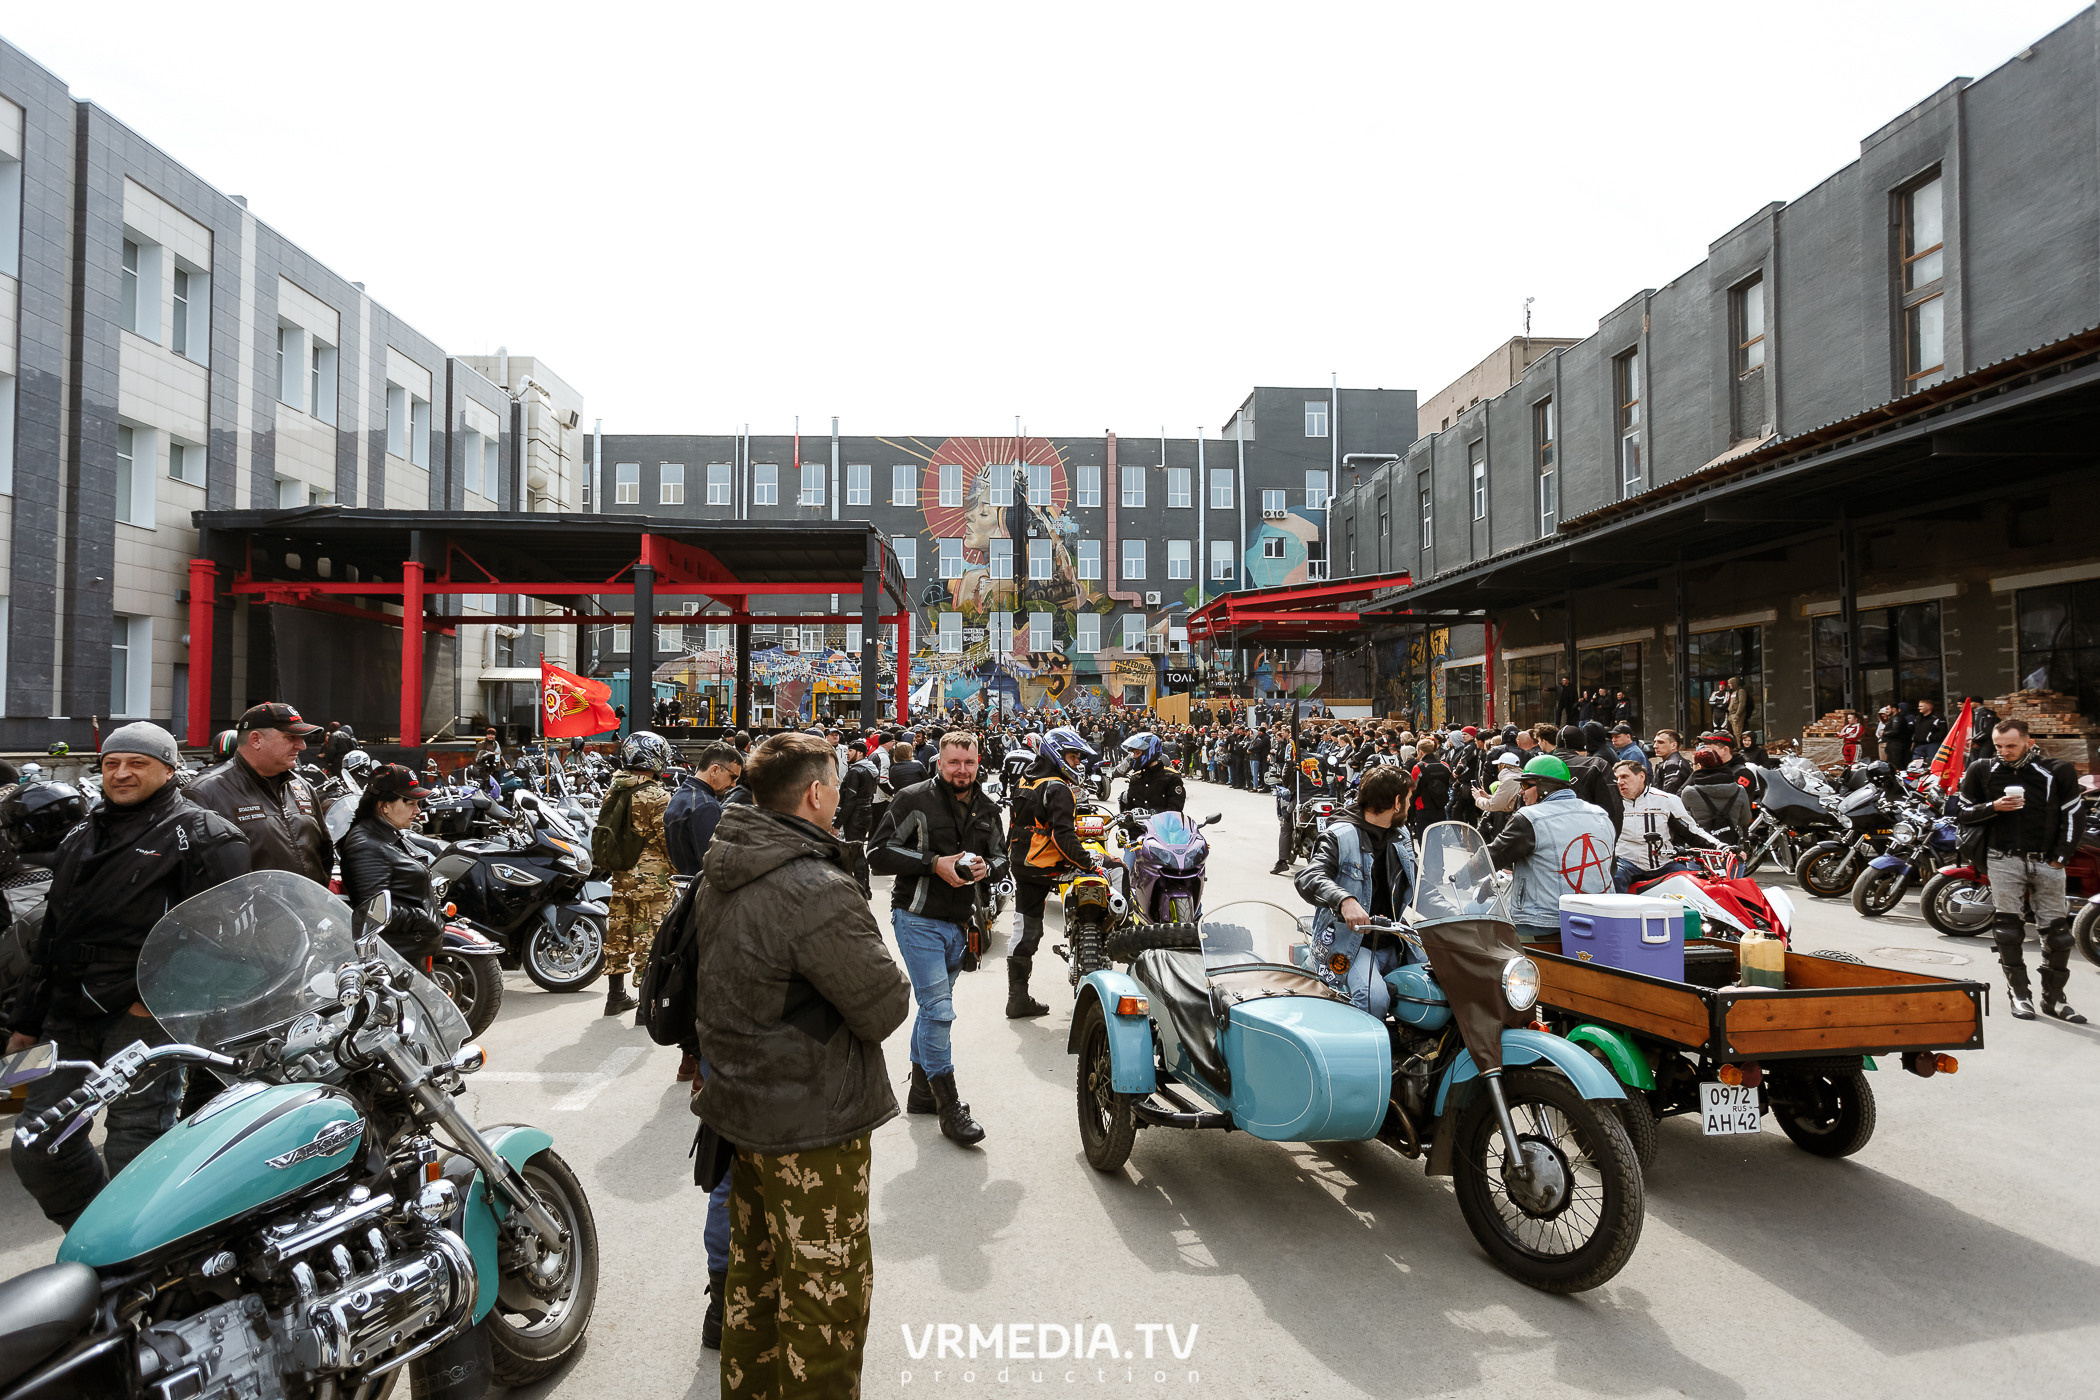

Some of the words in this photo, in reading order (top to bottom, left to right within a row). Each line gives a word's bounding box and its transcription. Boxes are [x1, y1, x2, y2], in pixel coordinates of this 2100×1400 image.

[1009, 761, 1026, 775] 71
[1710, 1087, 1750, 1105] 0972
[1738, 1112, 1757, 1131] 42
[268, 1120, 365, 1165] VALKYRIE
